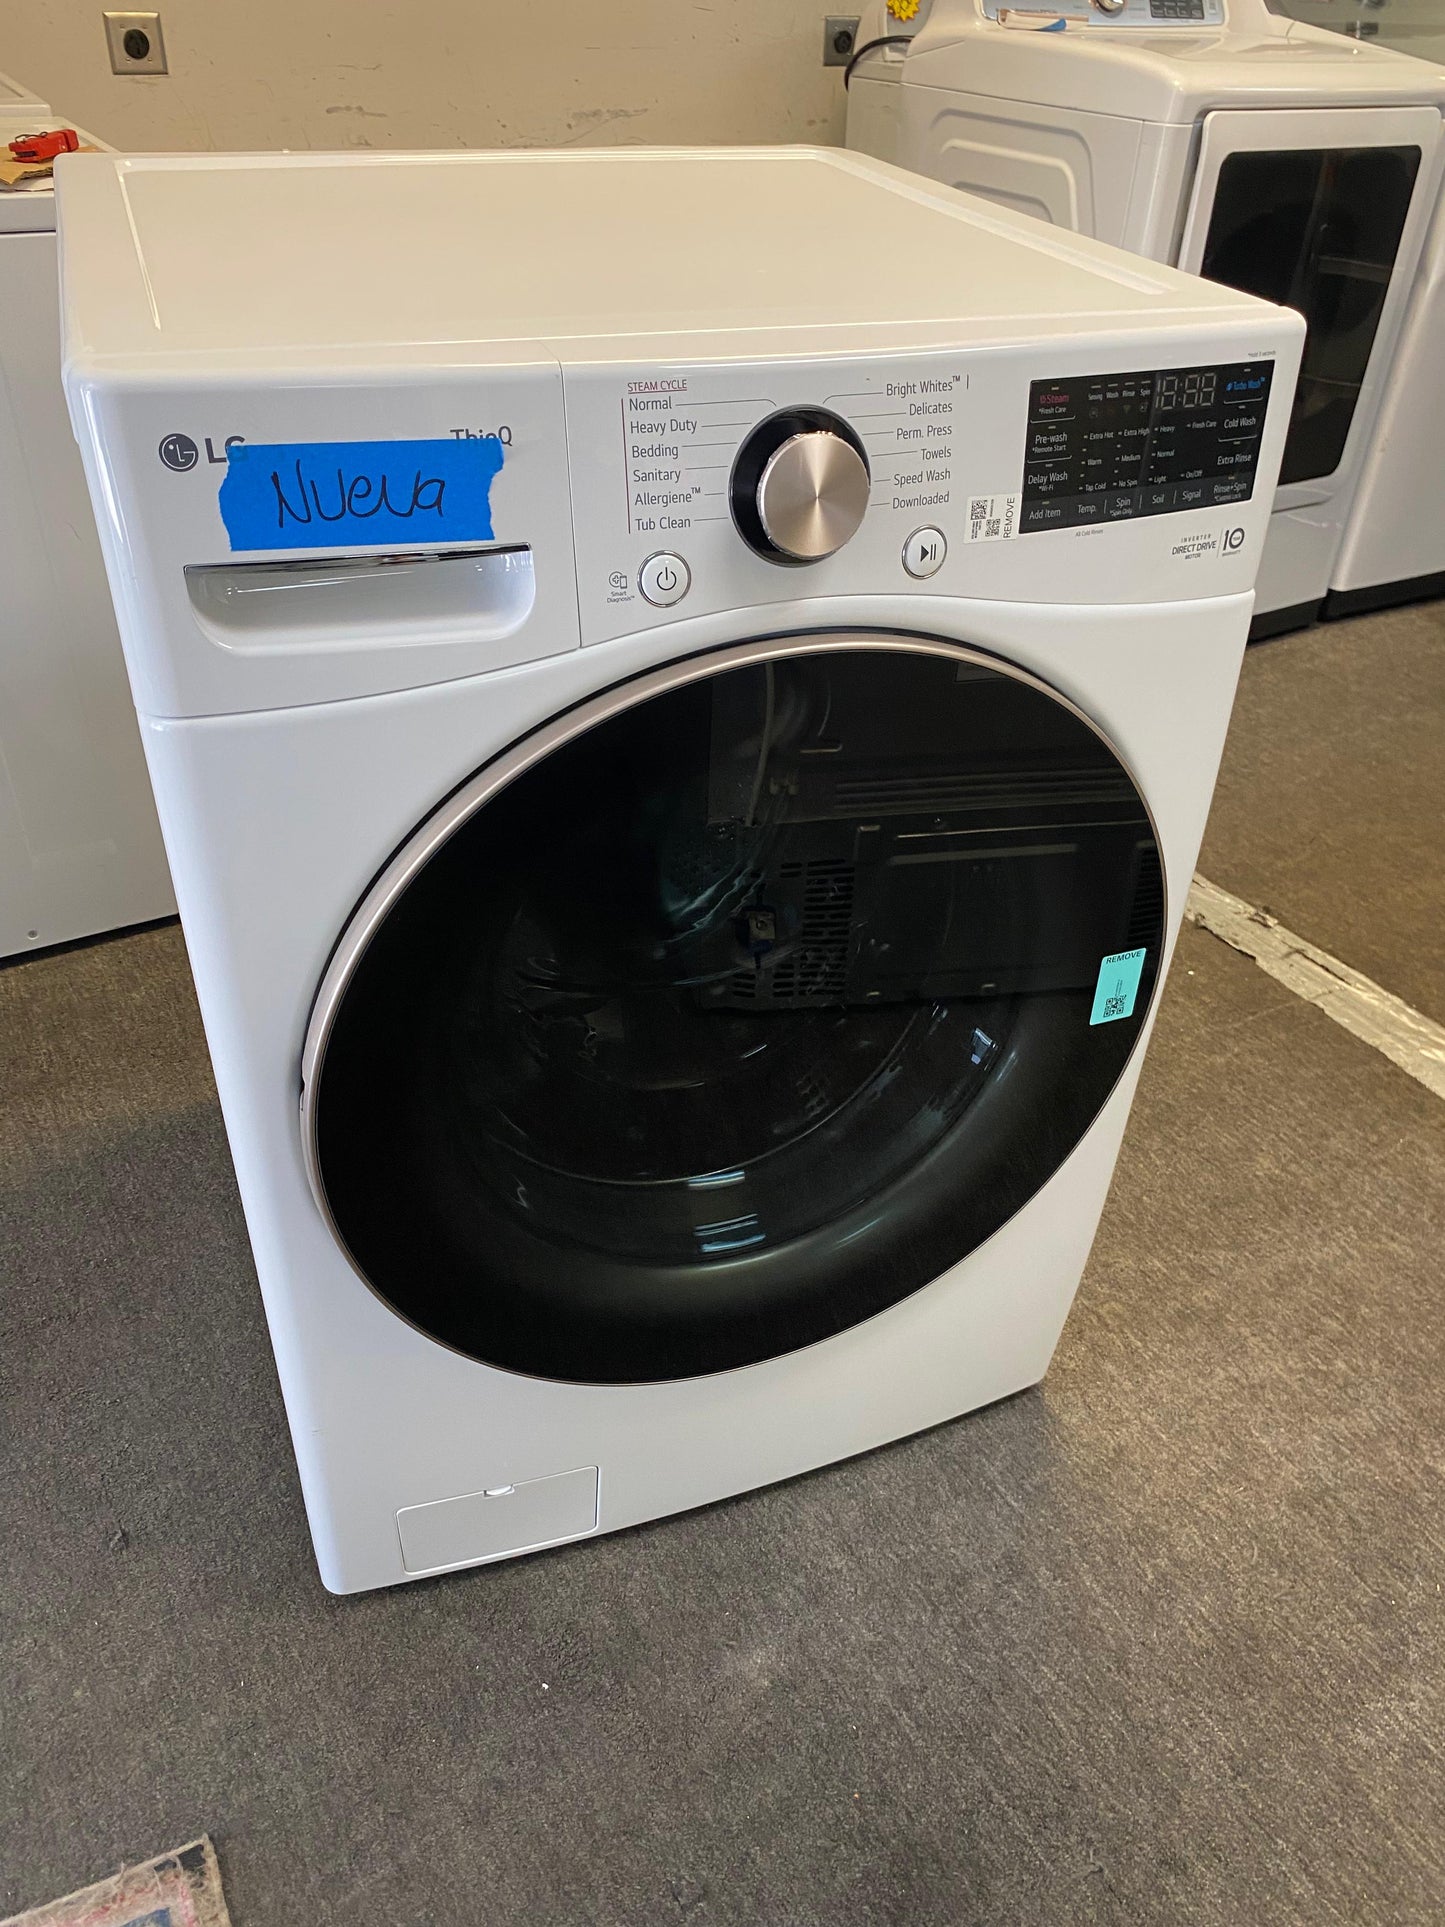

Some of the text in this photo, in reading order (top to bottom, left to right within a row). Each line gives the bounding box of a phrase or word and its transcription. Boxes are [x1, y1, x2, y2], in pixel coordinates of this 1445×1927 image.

[627, 379, 688, 392] STEAM CYCLE
[886, 382, 917, 399] Bright
[629, 396, 673, 411] Normal
[909, 402, 953, 416] Delicates
[630, 418, 698, 435] Heavy Duty
[1223, 416, 1257, 429] Cold Wash
[896, 424, 953, 441] Perm. Press
[1035, 432, 1068, 444] Pre-wash
[632, 444, 679, 459] Bedding
[921, 446, 952, 461] Towels
[1121, 454, 1141, 462] Medium
[1156, 449, 1175, 457] Normal
[1216, 453, 1252, 466] Extra Rinse
[633, 468, 681, 483] Sanitary
[894, 468, 951, 488] Speed Wash
[1027, 471, 1068, 485] Delay Wash
[892, 491, 950, 510] Downloaded
[1152, 494, 1165, 504] Soil
[1182, 488, 1202, 502] Signal
[1116, 497, 1131, 508] Spin
[1002, 496, 1016, 539] REMOVE
[1029, 508, 1061, 520] Add Item
[635, 515, 691, 531] Tub Clean
[1222, 527, 1246, 552] 10
[1172, 540, 1217, 556] DIRECT DRIVE
[1106, 951, 1142, 964] REMOVE
